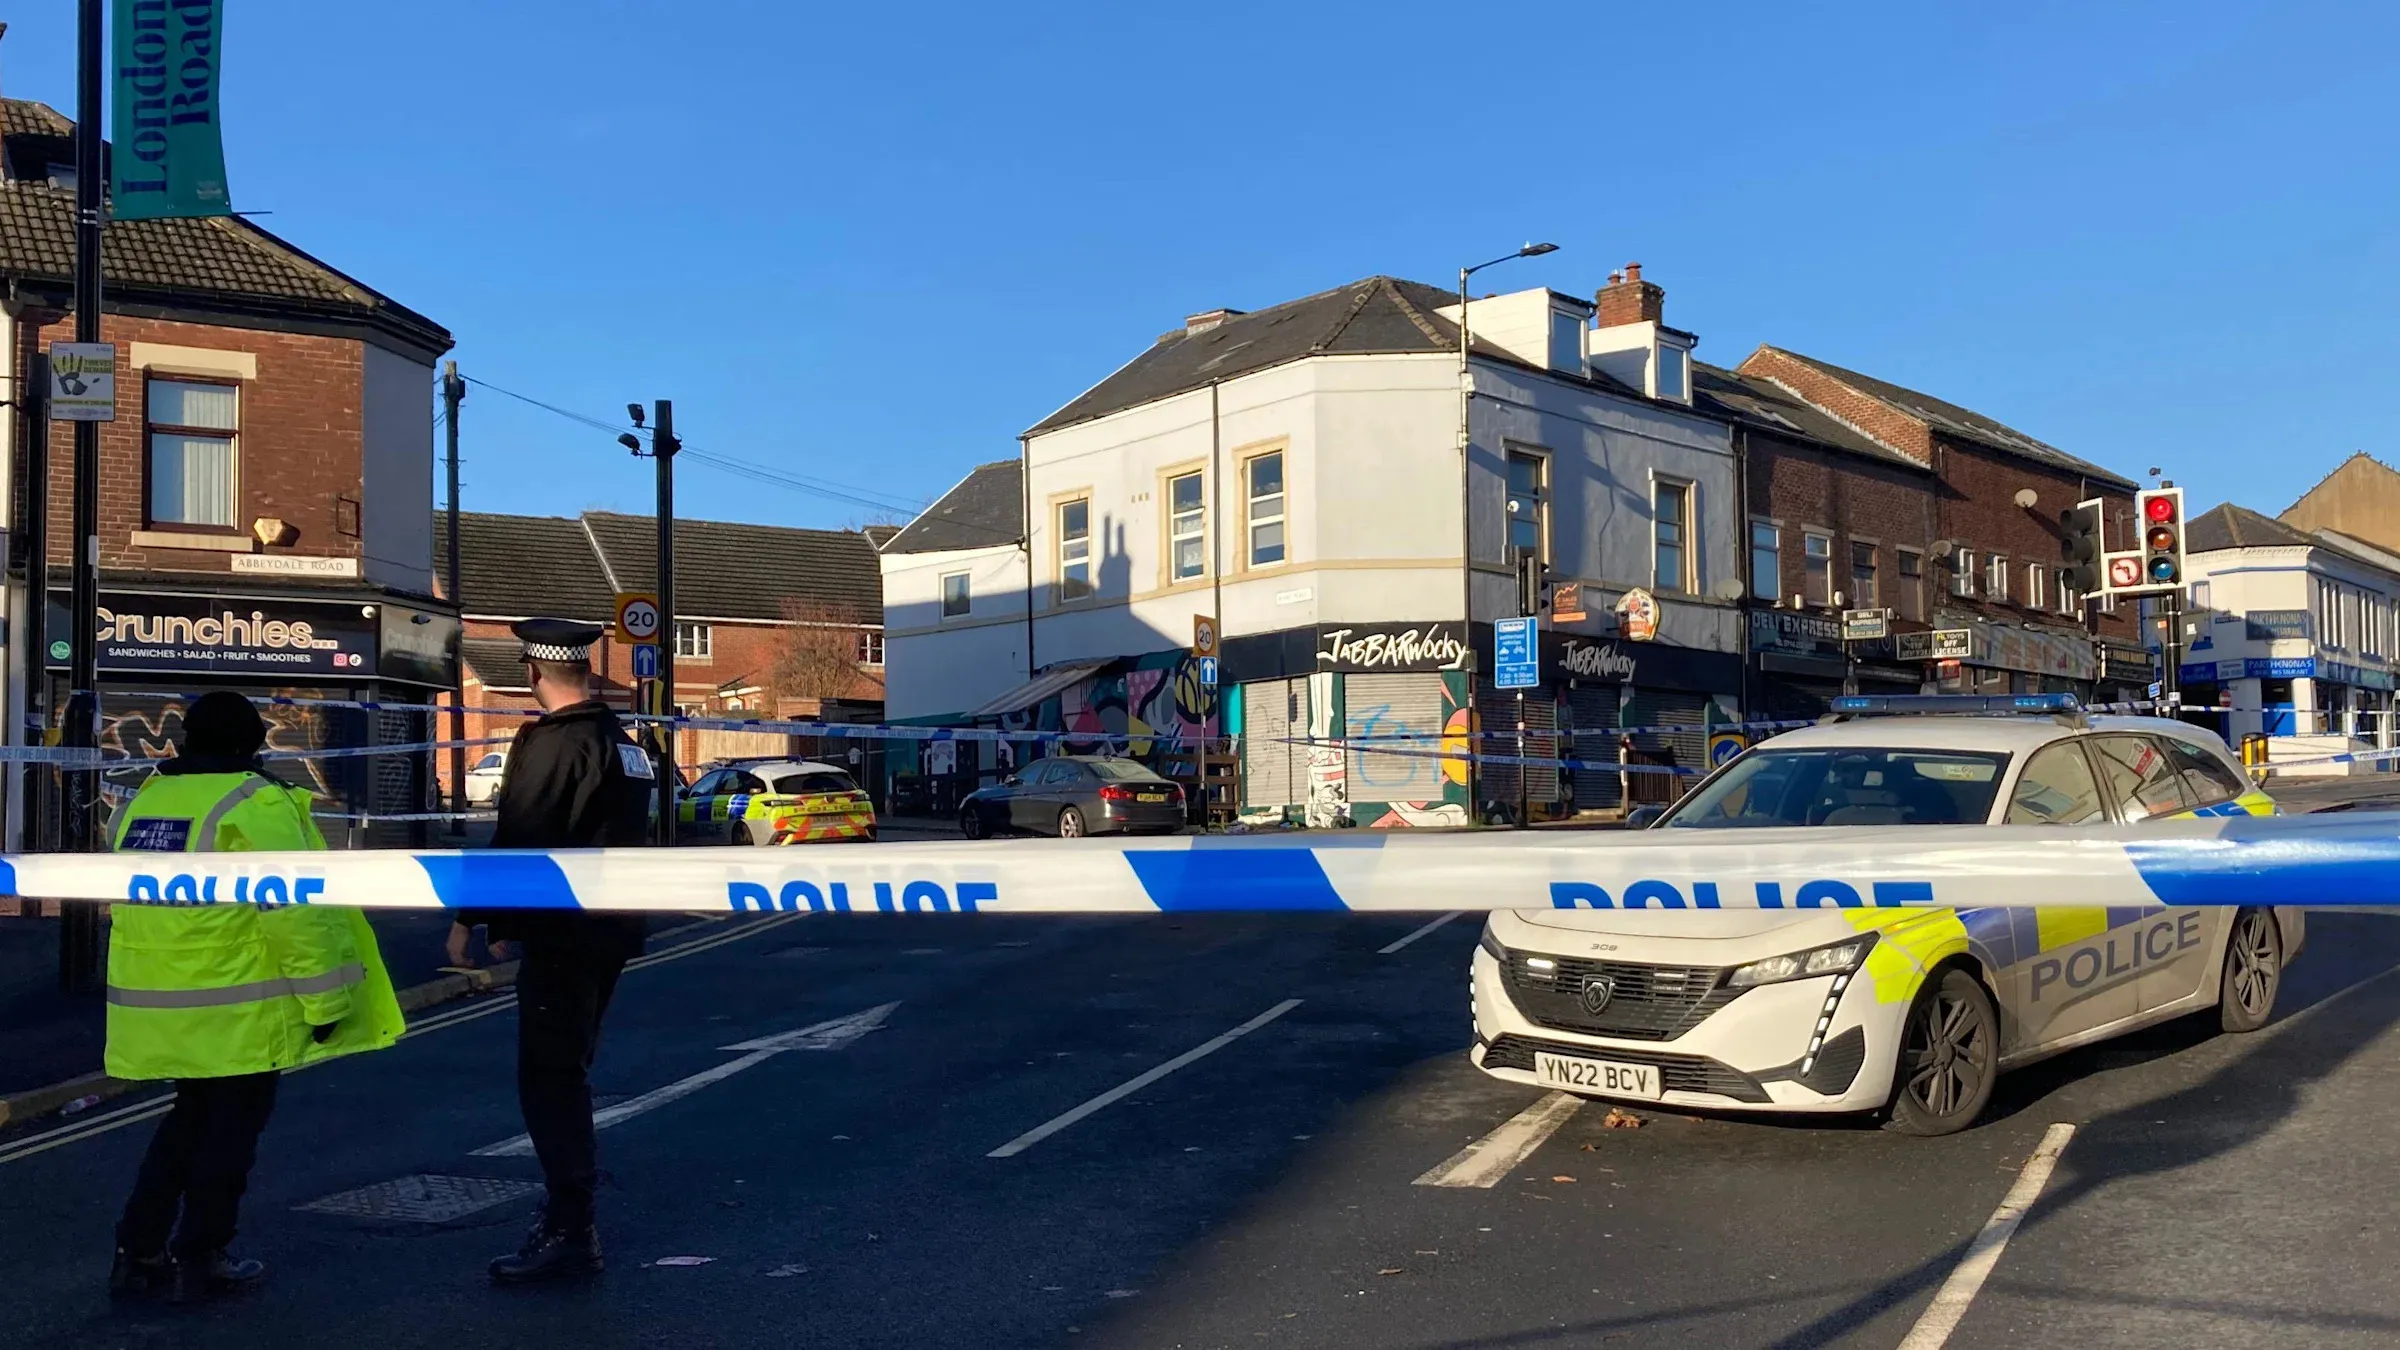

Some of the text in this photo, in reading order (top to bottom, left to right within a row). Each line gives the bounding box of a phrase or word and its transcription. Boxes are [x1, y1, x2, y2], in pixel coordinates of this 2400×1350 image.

[171, 0, 213, 126] Road
[120, 0, 167, 195] London
[238, 558, 344, 571] ABBEYDALE ROAD
[627, 611, 655, 628] 20
[1753, 611, 1839, 638] DELI EXPRESS
[1199, 629, 1211, 644] 20
[1943, 639, 1958, 647] OFF
[108, 647, 311, 664] SANDWICHES SALAD FRUIT SMOOTHIES
[1935, 647, 1967, 655] LICENSE
[793, 805, 864, 813] POLICE
[2031, 911, 2200, 1003] POLICE
[1545, 1058, 1646, 1092] YN22 BCV
